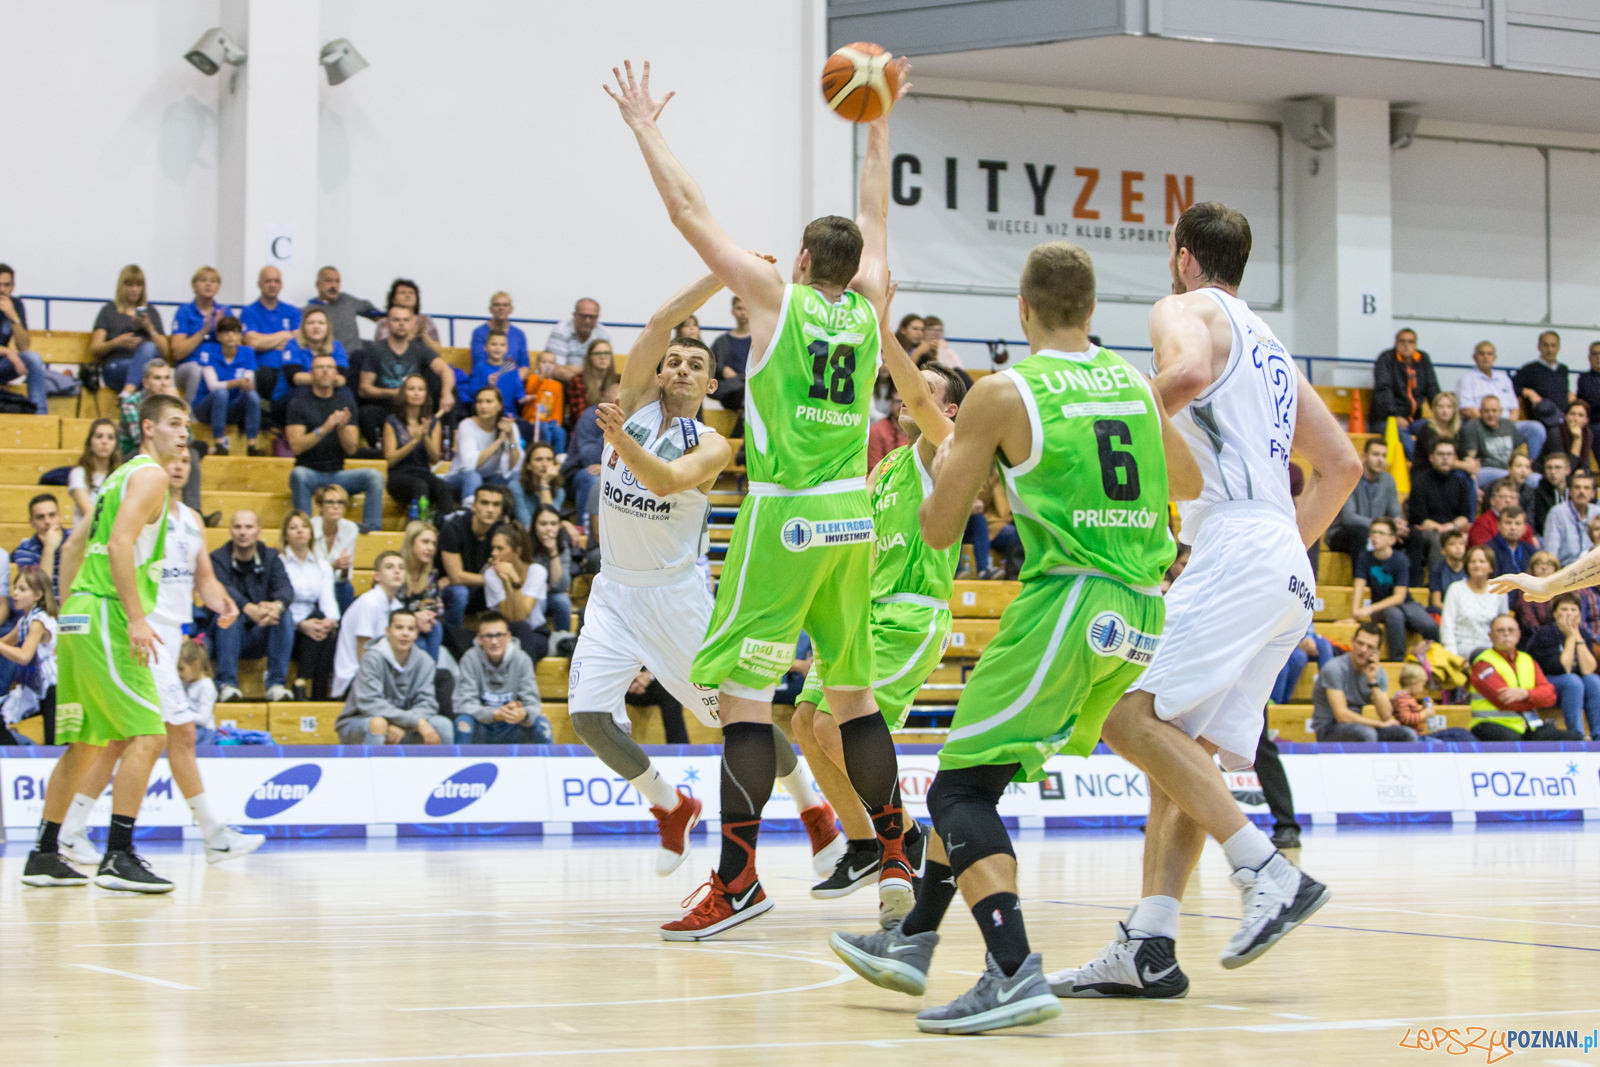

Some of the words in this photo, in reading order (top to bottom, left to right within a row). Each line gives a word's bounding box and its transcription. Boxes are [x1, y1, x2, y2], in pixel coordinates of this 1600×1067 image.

[891, 153, 1194, 225] CITYZEN
[1076, 225, 1112, 240] KLUB
[271, 236, 292, 260] C
[803, 296, 867, 329] UNIBEN
[1361, 294, 1377, 315] B
[807, 340, 856, 405] 18
[1040, 364, 1144, 394] UNIBEN
[795, 405, 863, 427] PRUSZKÓW
[1093, 420, 1141, 501] 6
[604, 481, 671, 514] BIOFARM
[825, 532, 871, 543] INVESTMENT
[254, 781, 310, 800] atrem
[434, 780, 487, 798] atrem
[1075, 774, 1143, 797] NICK
